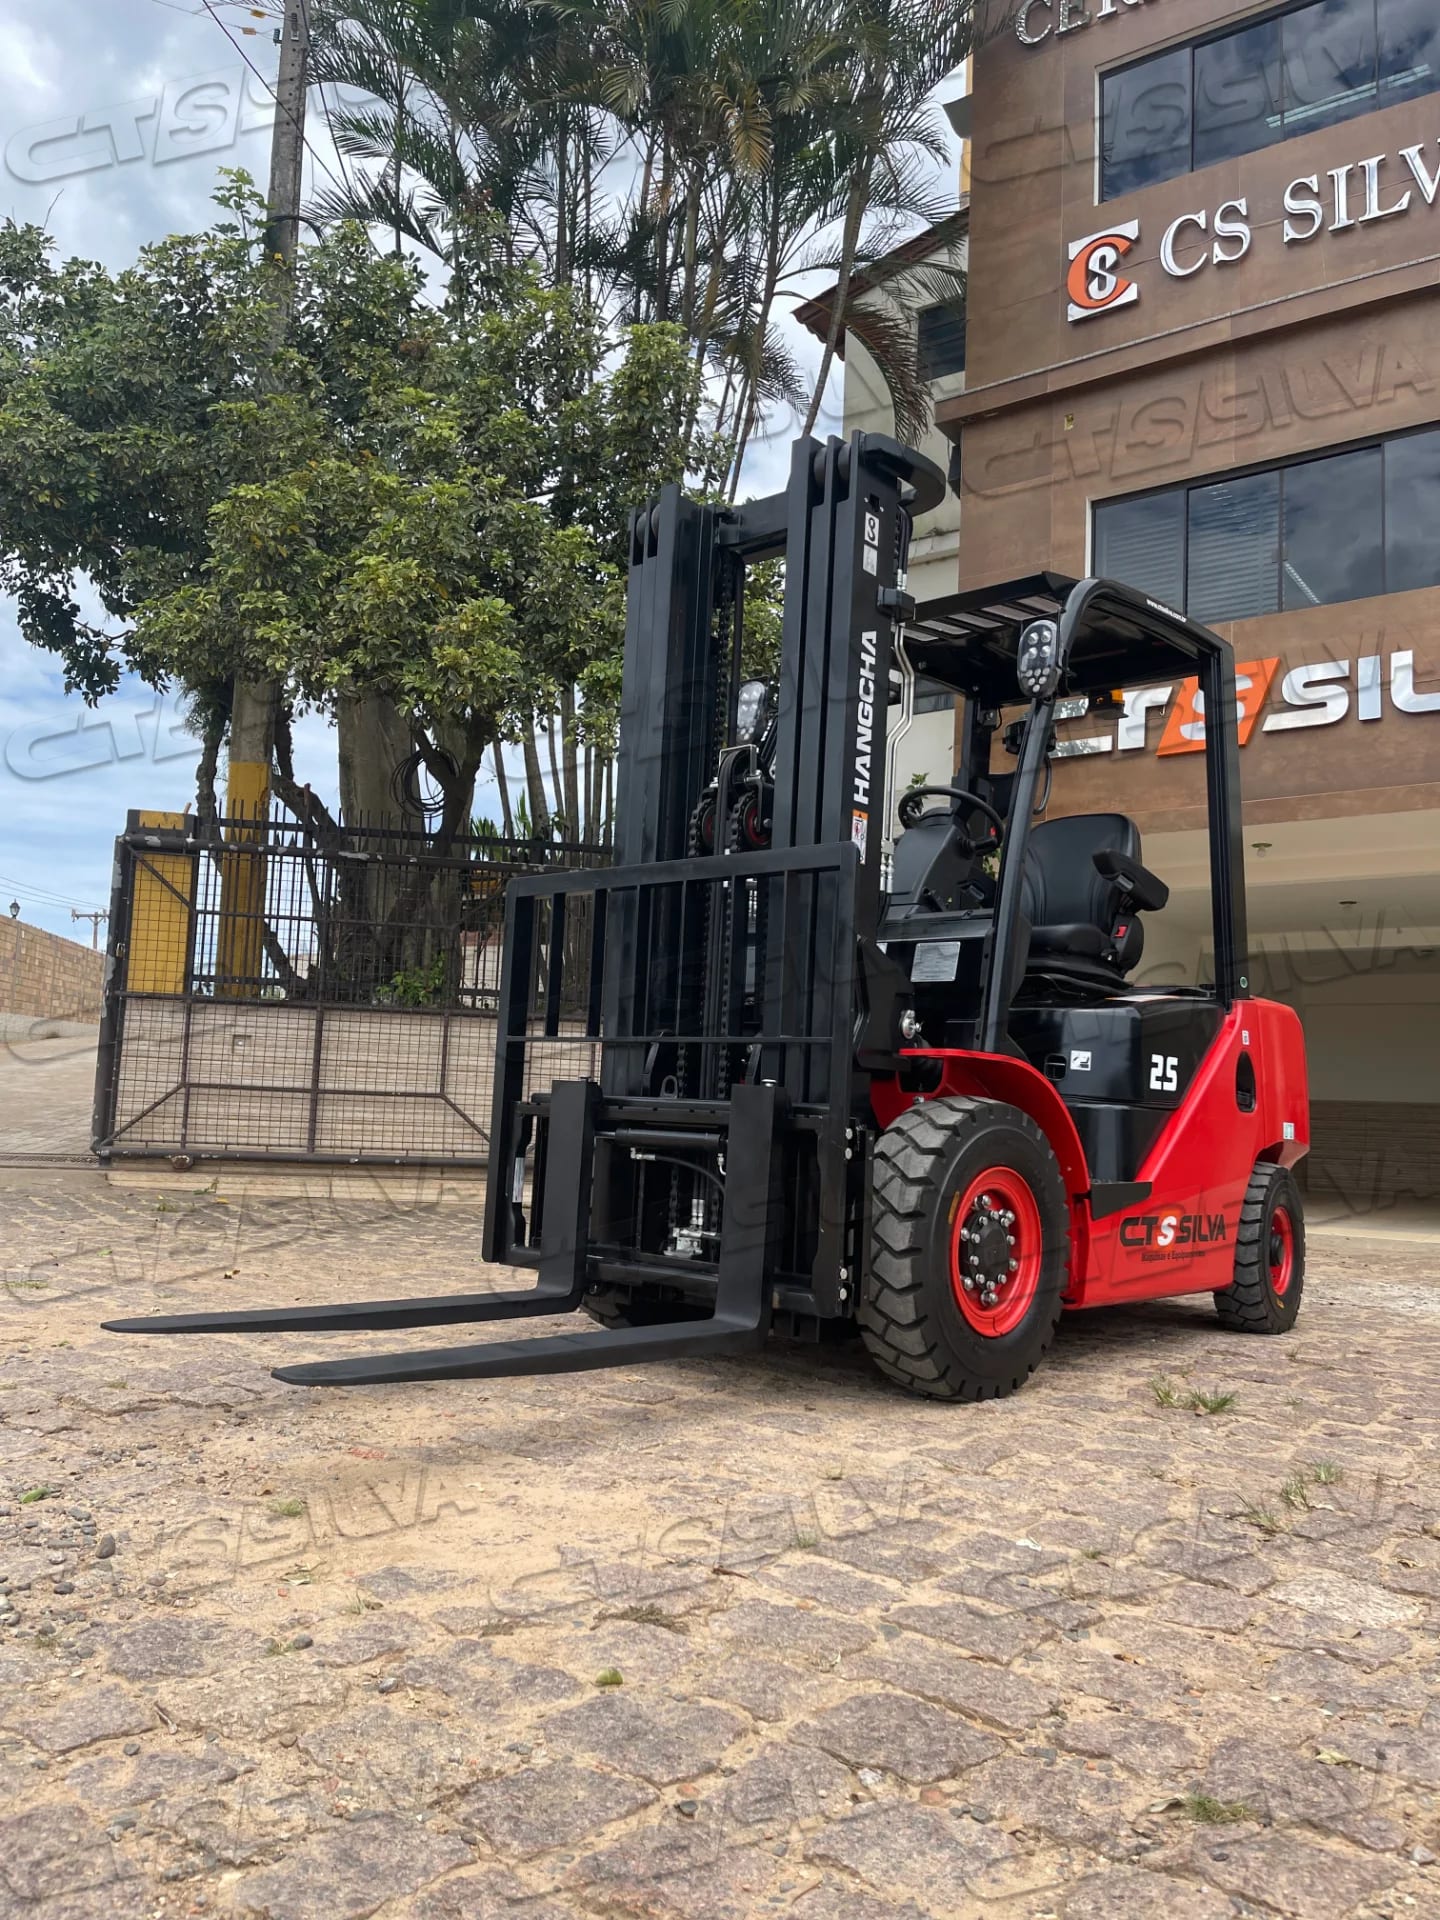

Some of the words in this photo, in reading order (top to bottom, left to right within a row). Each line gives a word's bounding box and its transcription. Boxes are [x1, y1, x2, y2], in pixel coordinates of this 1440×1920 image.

[1160, 197, 1251, 278] CS
[852, 630, 877, 805] HANGCHA
[1149, 1053, 1179, 1092] 25
